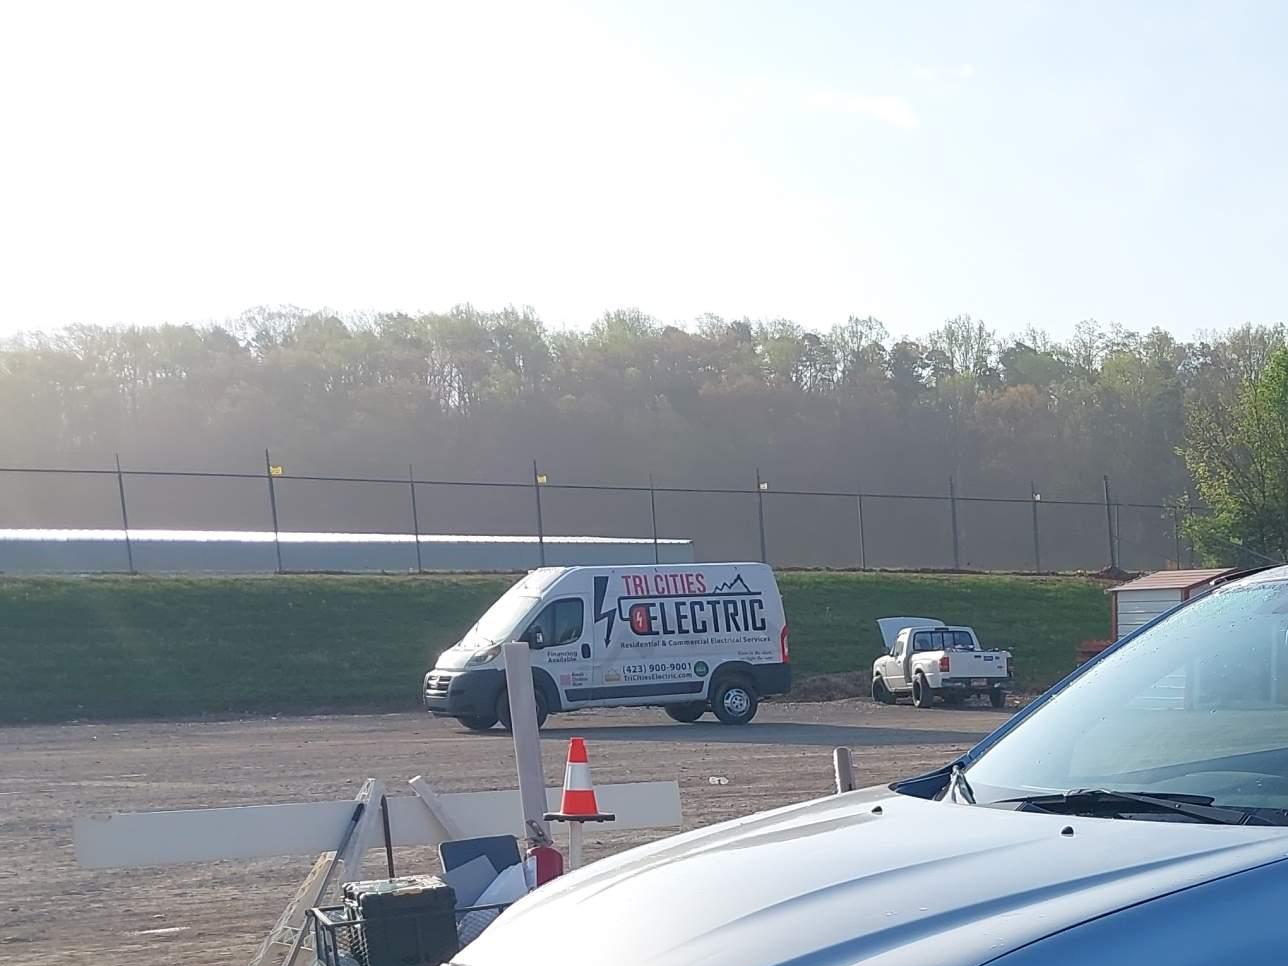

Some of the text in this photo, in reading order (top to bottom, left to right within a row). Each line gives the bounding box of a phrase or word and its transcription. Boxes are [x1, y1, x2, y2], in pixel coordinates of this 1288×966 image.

[621, 573, 707, 596] TRI CITIES
[630, 599, 767, 636] ELECTRIC
[620, 640, 660, 648] Residential
[668, 638, 709, 647] Commercial
[711, 636, 742, 644] Electrical
[622, 662, 692, 674] (423) 900-9001
[623, 673, 693, 682] TriCitiesElectric.com
